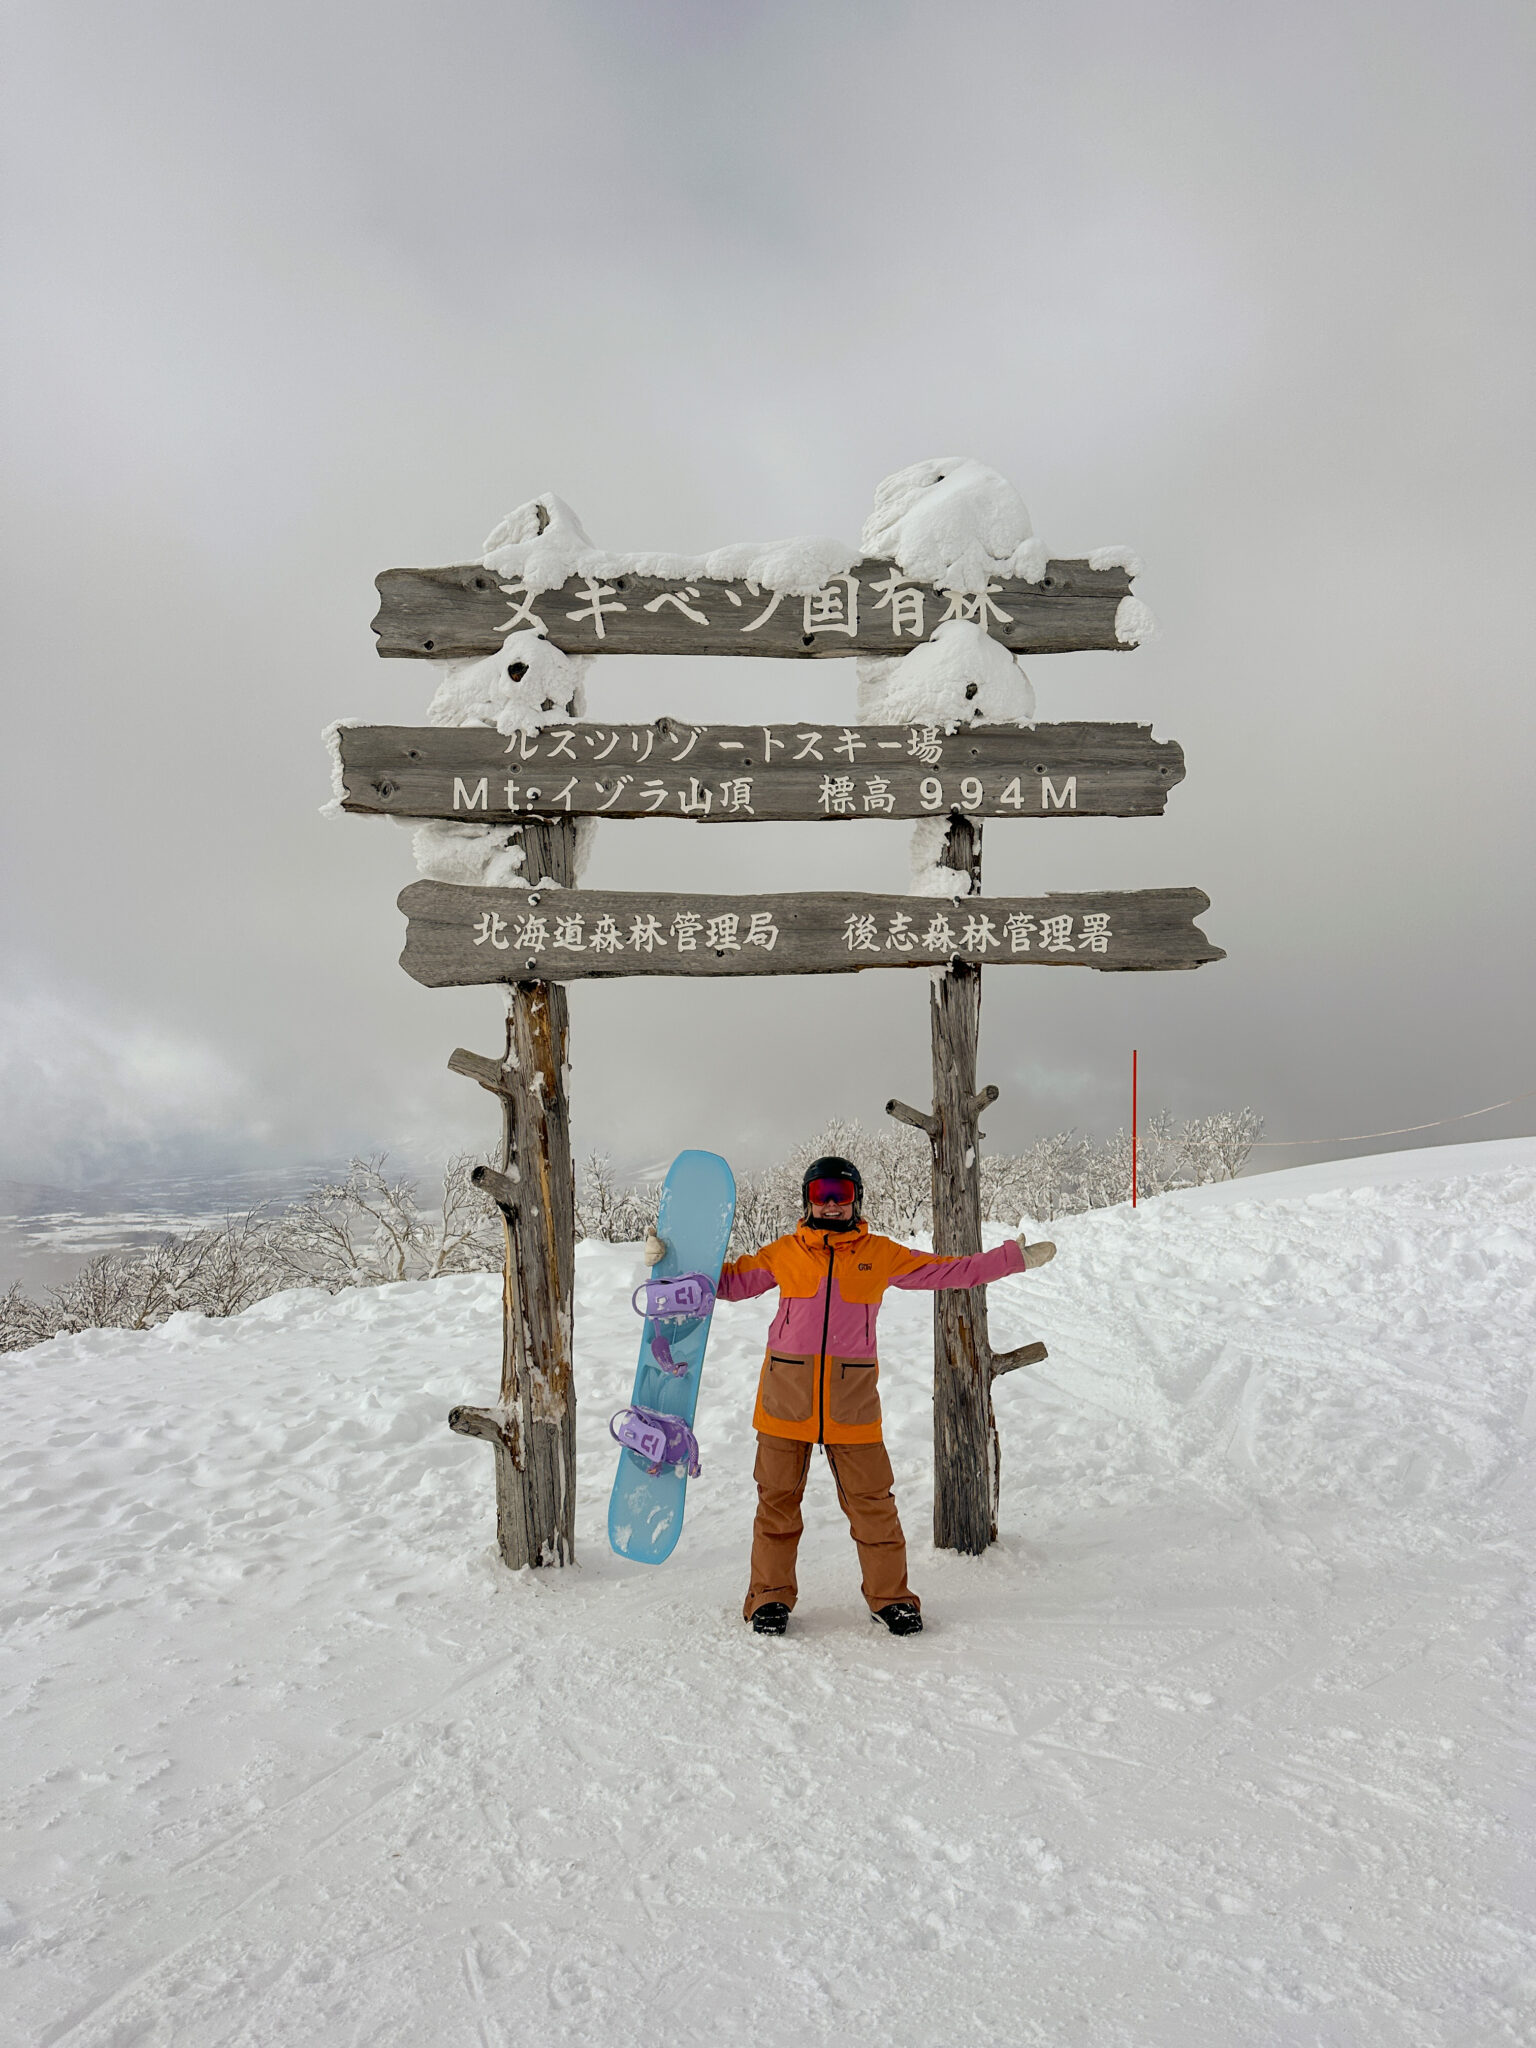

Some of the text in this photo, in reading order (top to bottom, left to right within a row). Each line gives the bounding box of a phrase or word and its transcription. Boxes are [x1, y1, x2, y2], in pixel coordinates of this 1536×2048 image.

[504, 727, 943, 763] ルスツリゾートスキー場
[473, 911, 1113, 953] 北海道森林管理局 後志森林管理署
